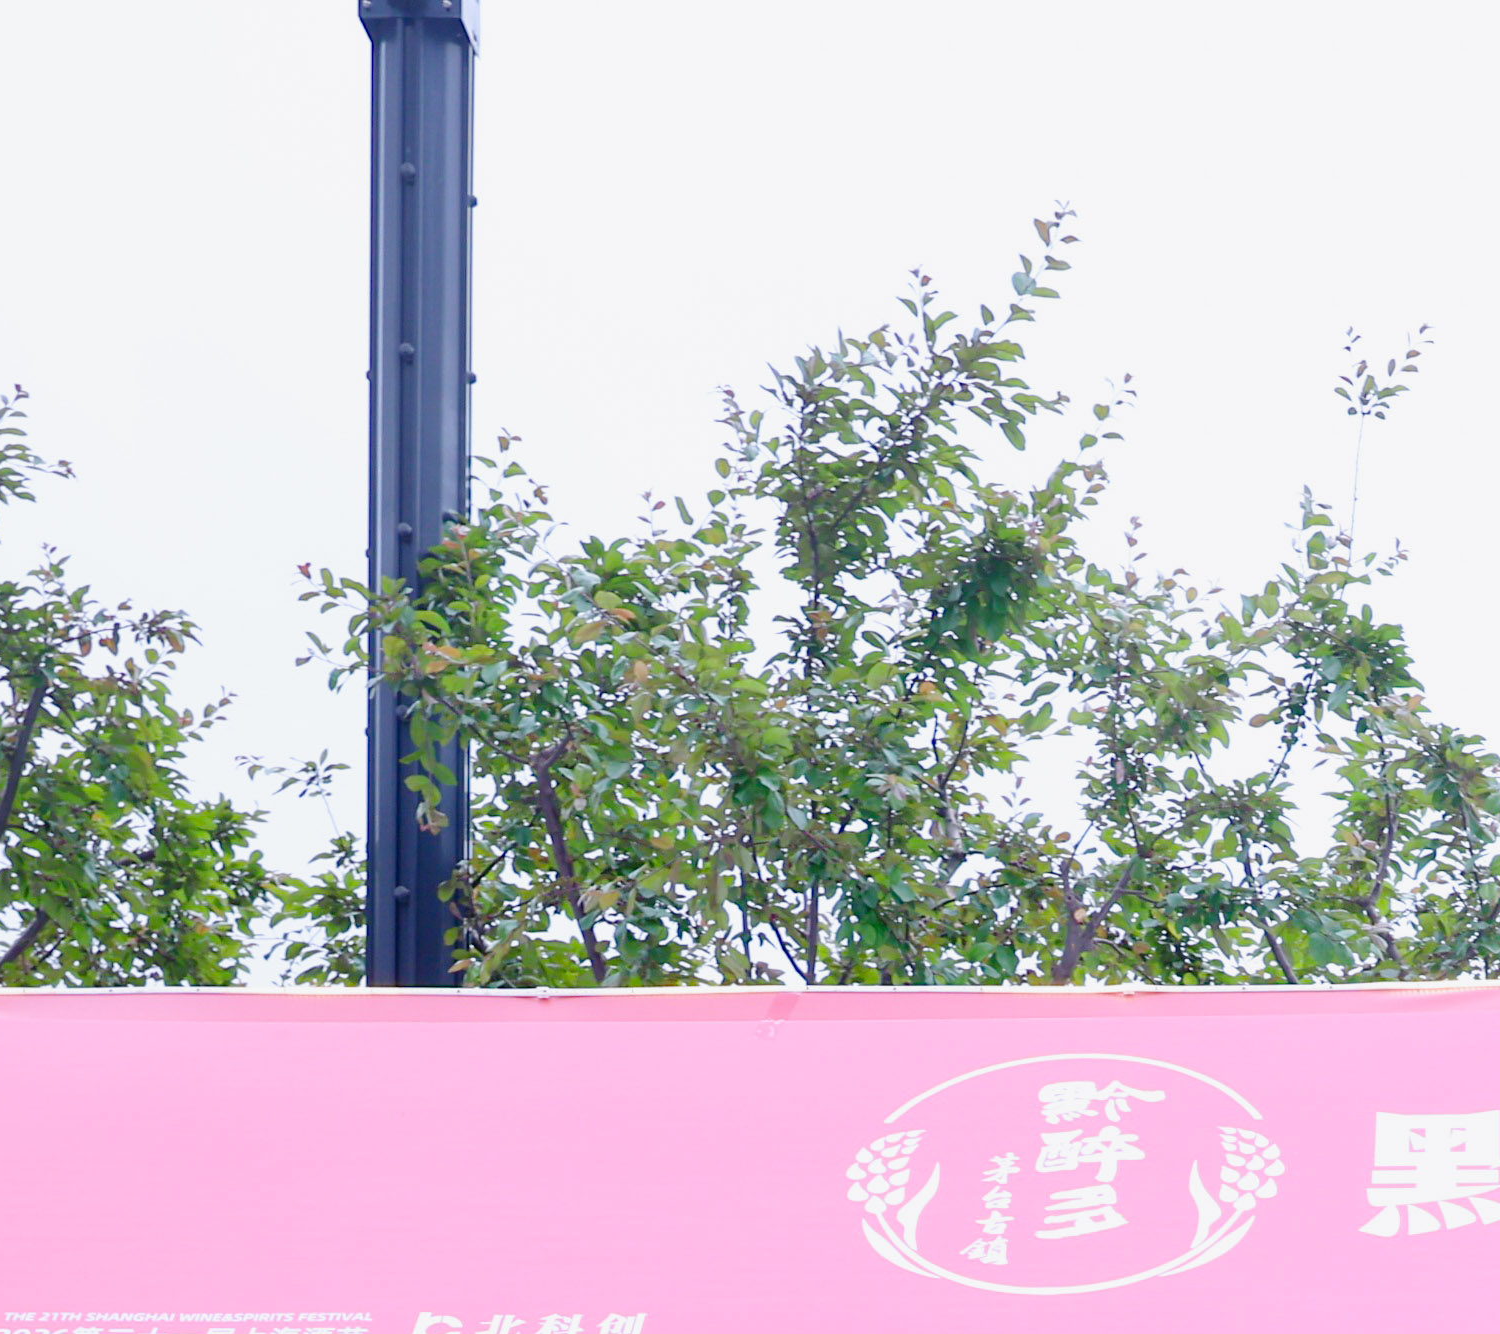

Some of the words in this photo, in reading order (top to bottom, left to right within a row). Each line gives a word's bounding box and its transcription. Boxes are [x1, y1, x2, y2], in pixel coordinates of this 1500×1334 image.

[1034, 1080, 1166, 1240] 黔醉多
[4, 1312, 37, 1322] THE
[40, 1312, 83, 1322] 21TH
[86, 1312, 176, 1322] SHANGHAI
[179, 1312, 295, 1322] WINE&SPIRITS
[299, 1312, 373, 1322] FESTIVAL
